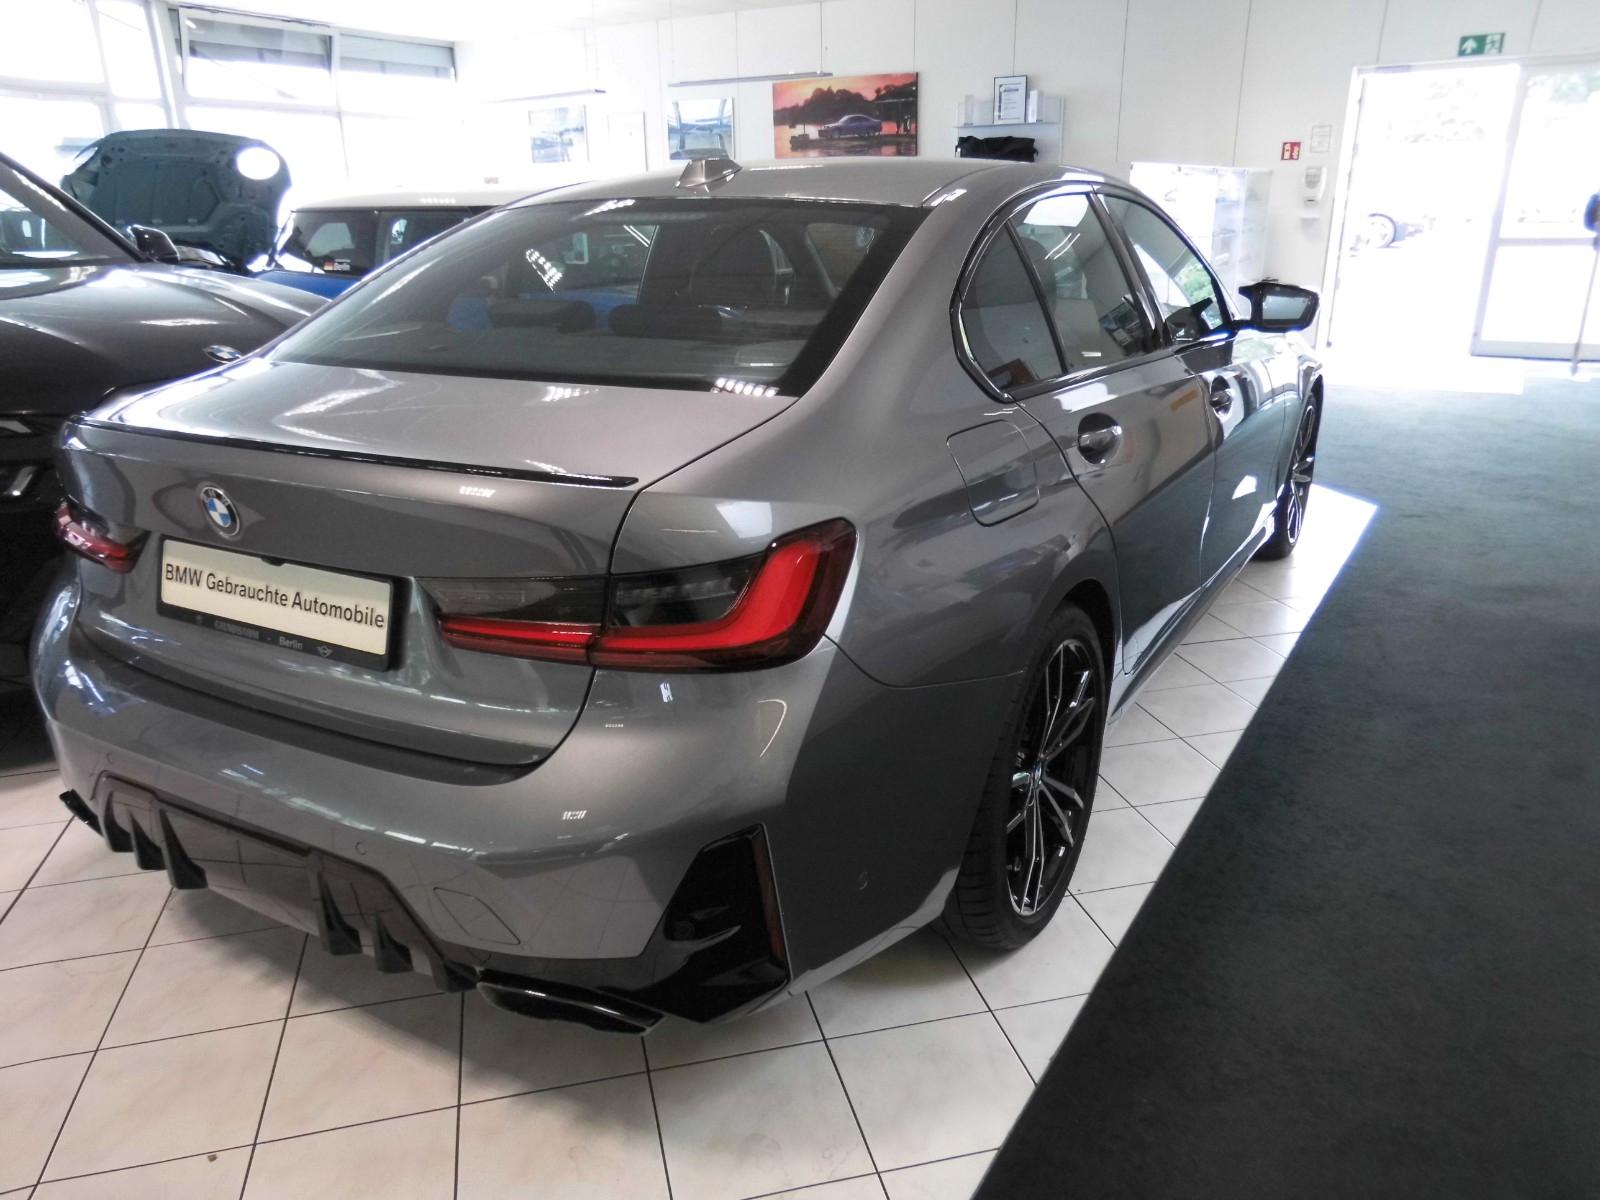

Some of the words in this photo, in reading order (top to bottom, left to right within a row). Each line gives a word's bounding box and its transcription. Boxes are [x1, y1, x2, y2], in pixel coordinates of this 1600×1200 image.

[165, 563, 203, 587] BMW
[206, 573, 288, 607] Gebrauchte
[291, 592, 385, 628] Automobile
[279, 636, 303, 650] Berlin
